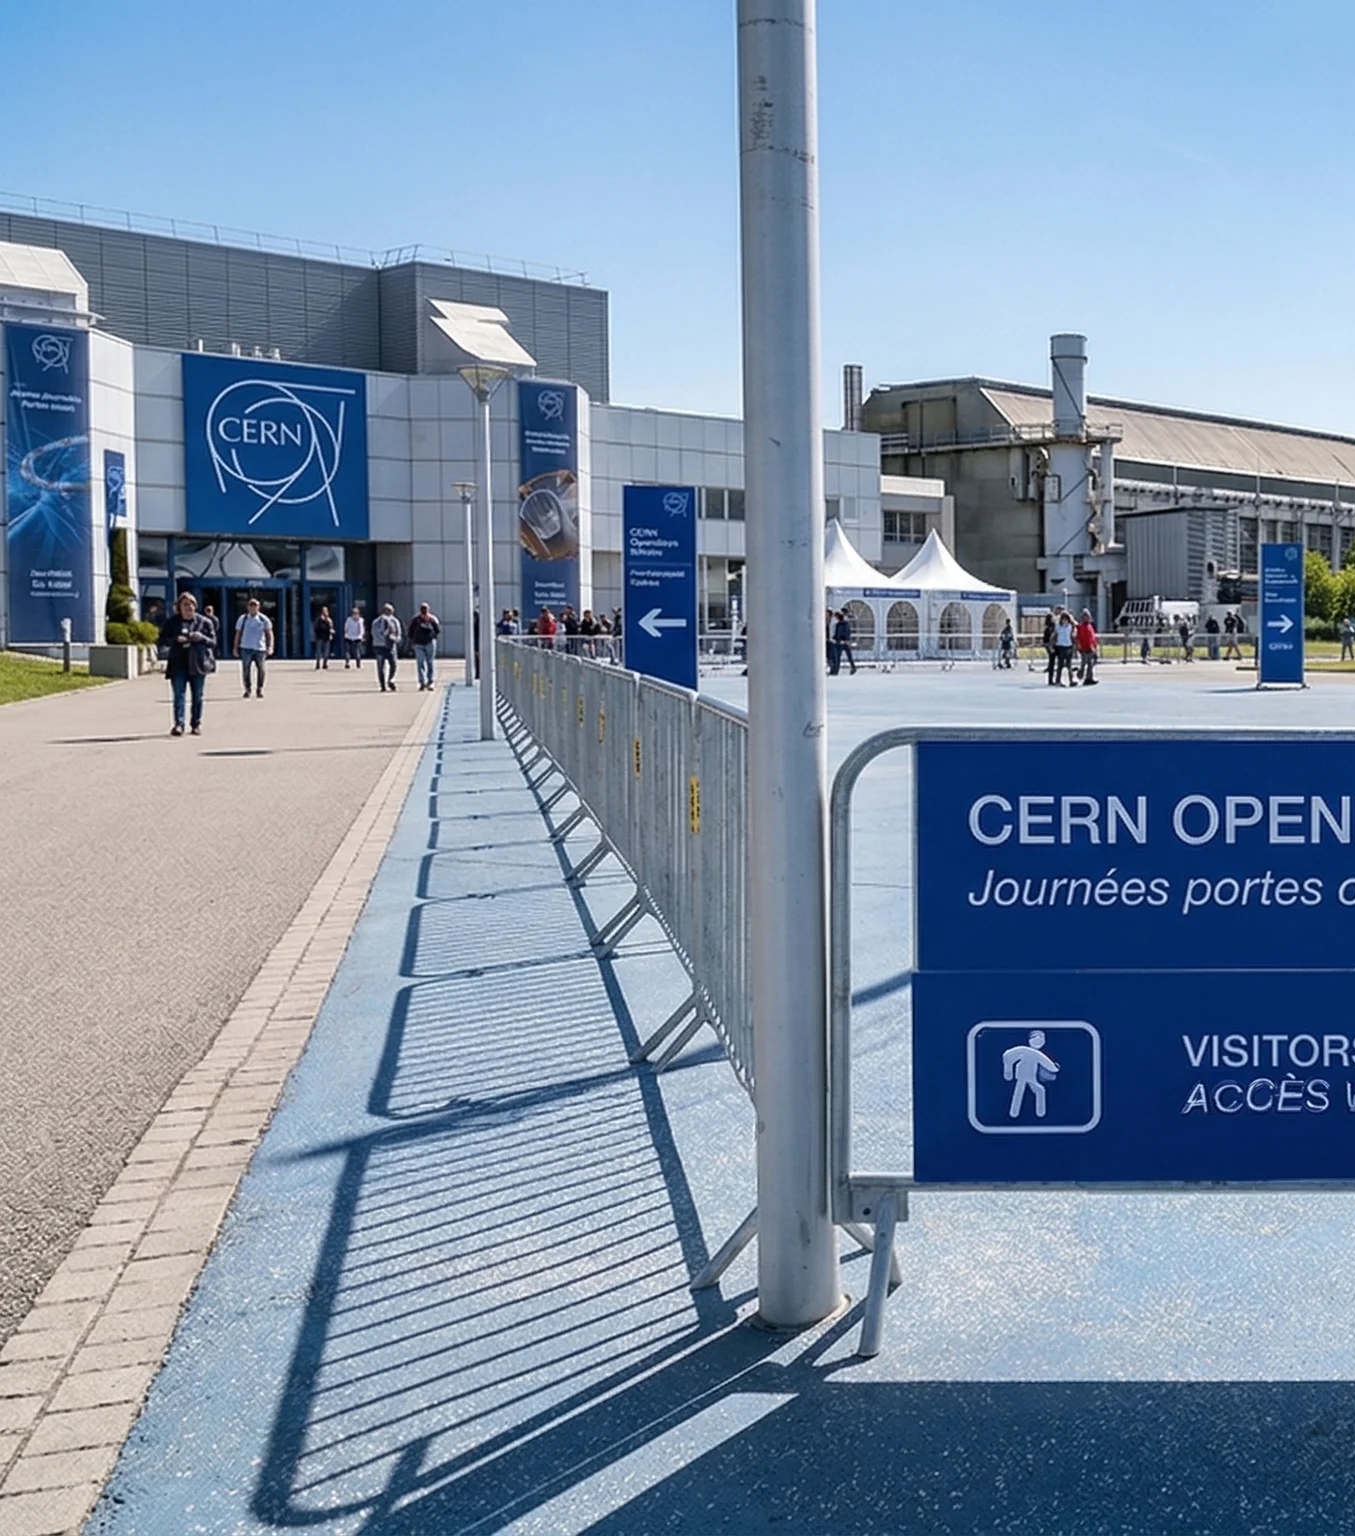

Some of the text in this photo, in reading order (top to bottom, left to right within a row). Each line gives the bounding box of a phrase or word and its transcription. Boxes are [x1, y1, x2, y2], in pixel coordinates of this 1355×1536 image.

[218, 416, 301, 447] CERN
[968, 794, 1148, 846] CERN
[968, 867, 1170, 907] Journées
[1182, 870, 1324, 916] portes
[1181, 1072, 1331, 1114] ACCÈS
